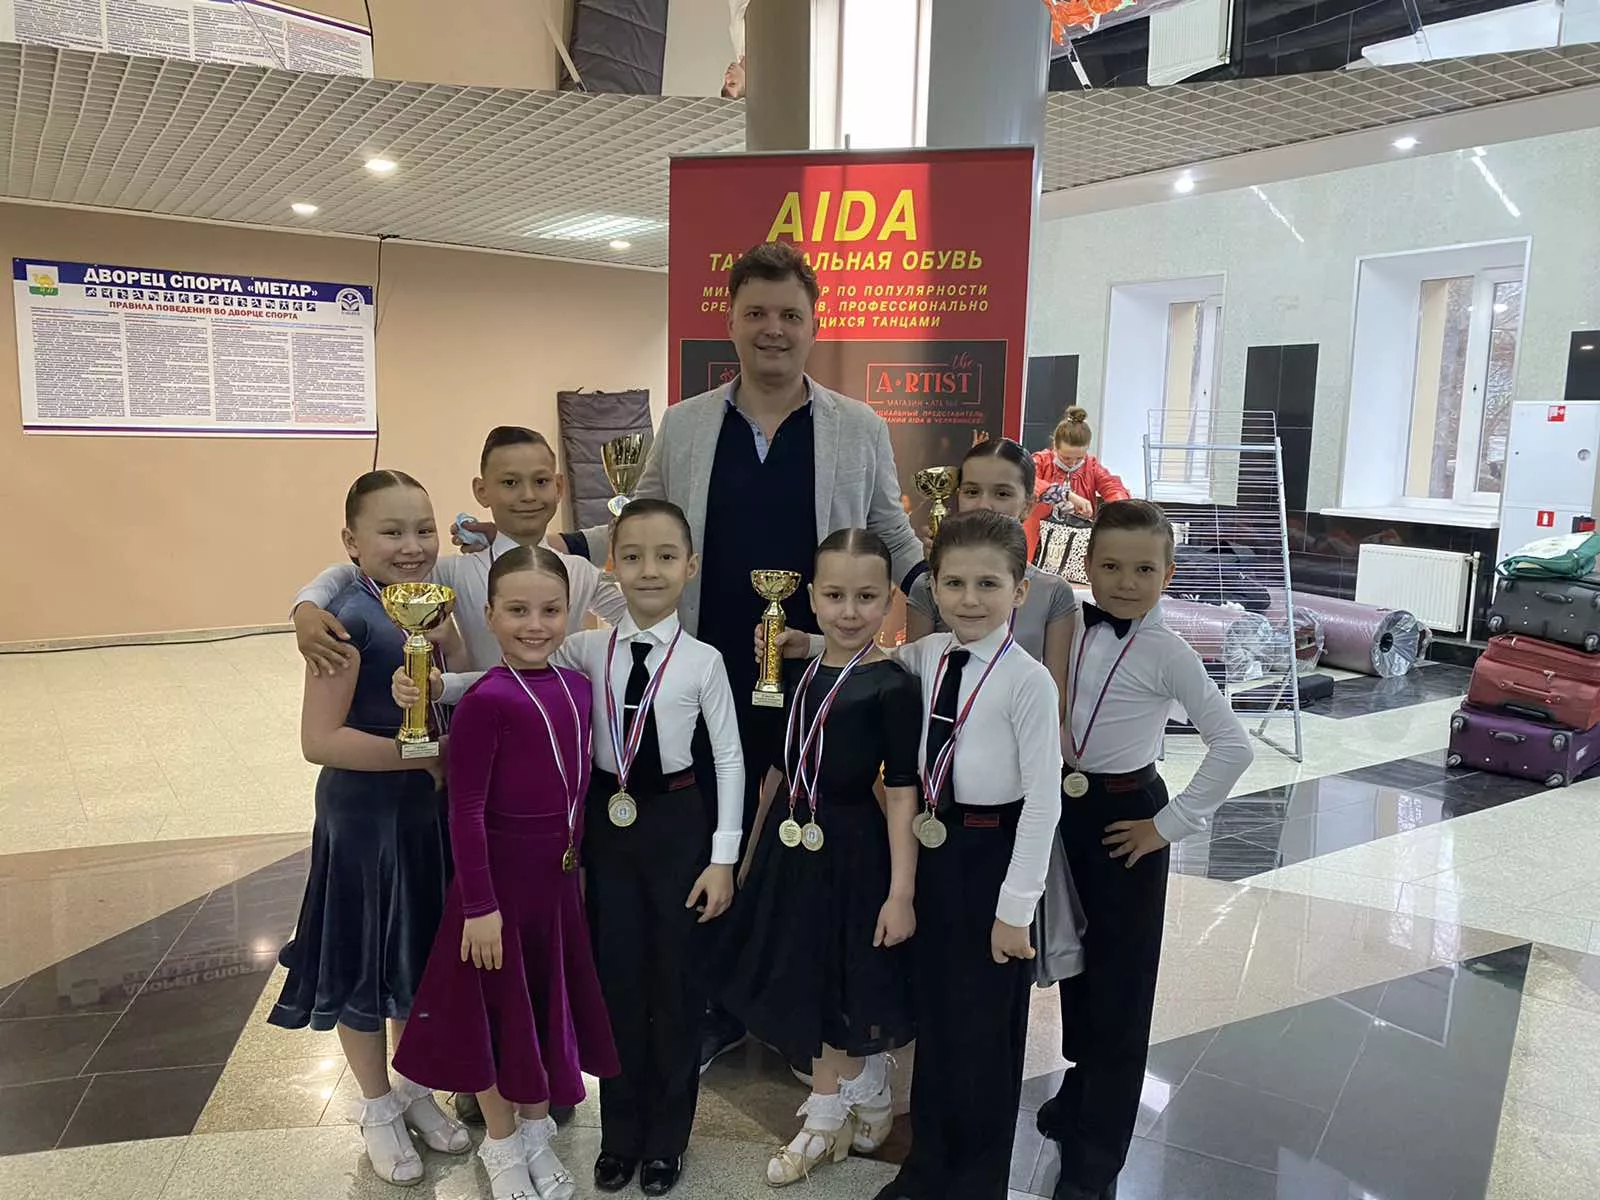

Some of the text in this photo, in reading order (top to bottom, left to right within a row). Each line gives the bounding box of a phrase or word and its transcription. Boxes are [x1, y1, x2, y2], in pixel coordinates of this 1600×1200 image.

[766, 189, 917, 242] AIDA
[902, 250, 983, 271] ОБУВЬ
[83, 267, 318, 297] ДВОРЕЦ СПОРТА «МЕТАР»
[837, 286, 857, 297] ПО
[864, 284, 988, 297] ПОПУЛЯРНОСТИ
[109, 301, 298, 320] ПРАВИЛА ПОВЕДЕНИЯ ВО ДВОРЦЕ СПОРТА
[839, 300, 989, 313] ПРОФЕССИОНАЛЬНО
[872, 316, 941, 328] ТАНЦАМИ
